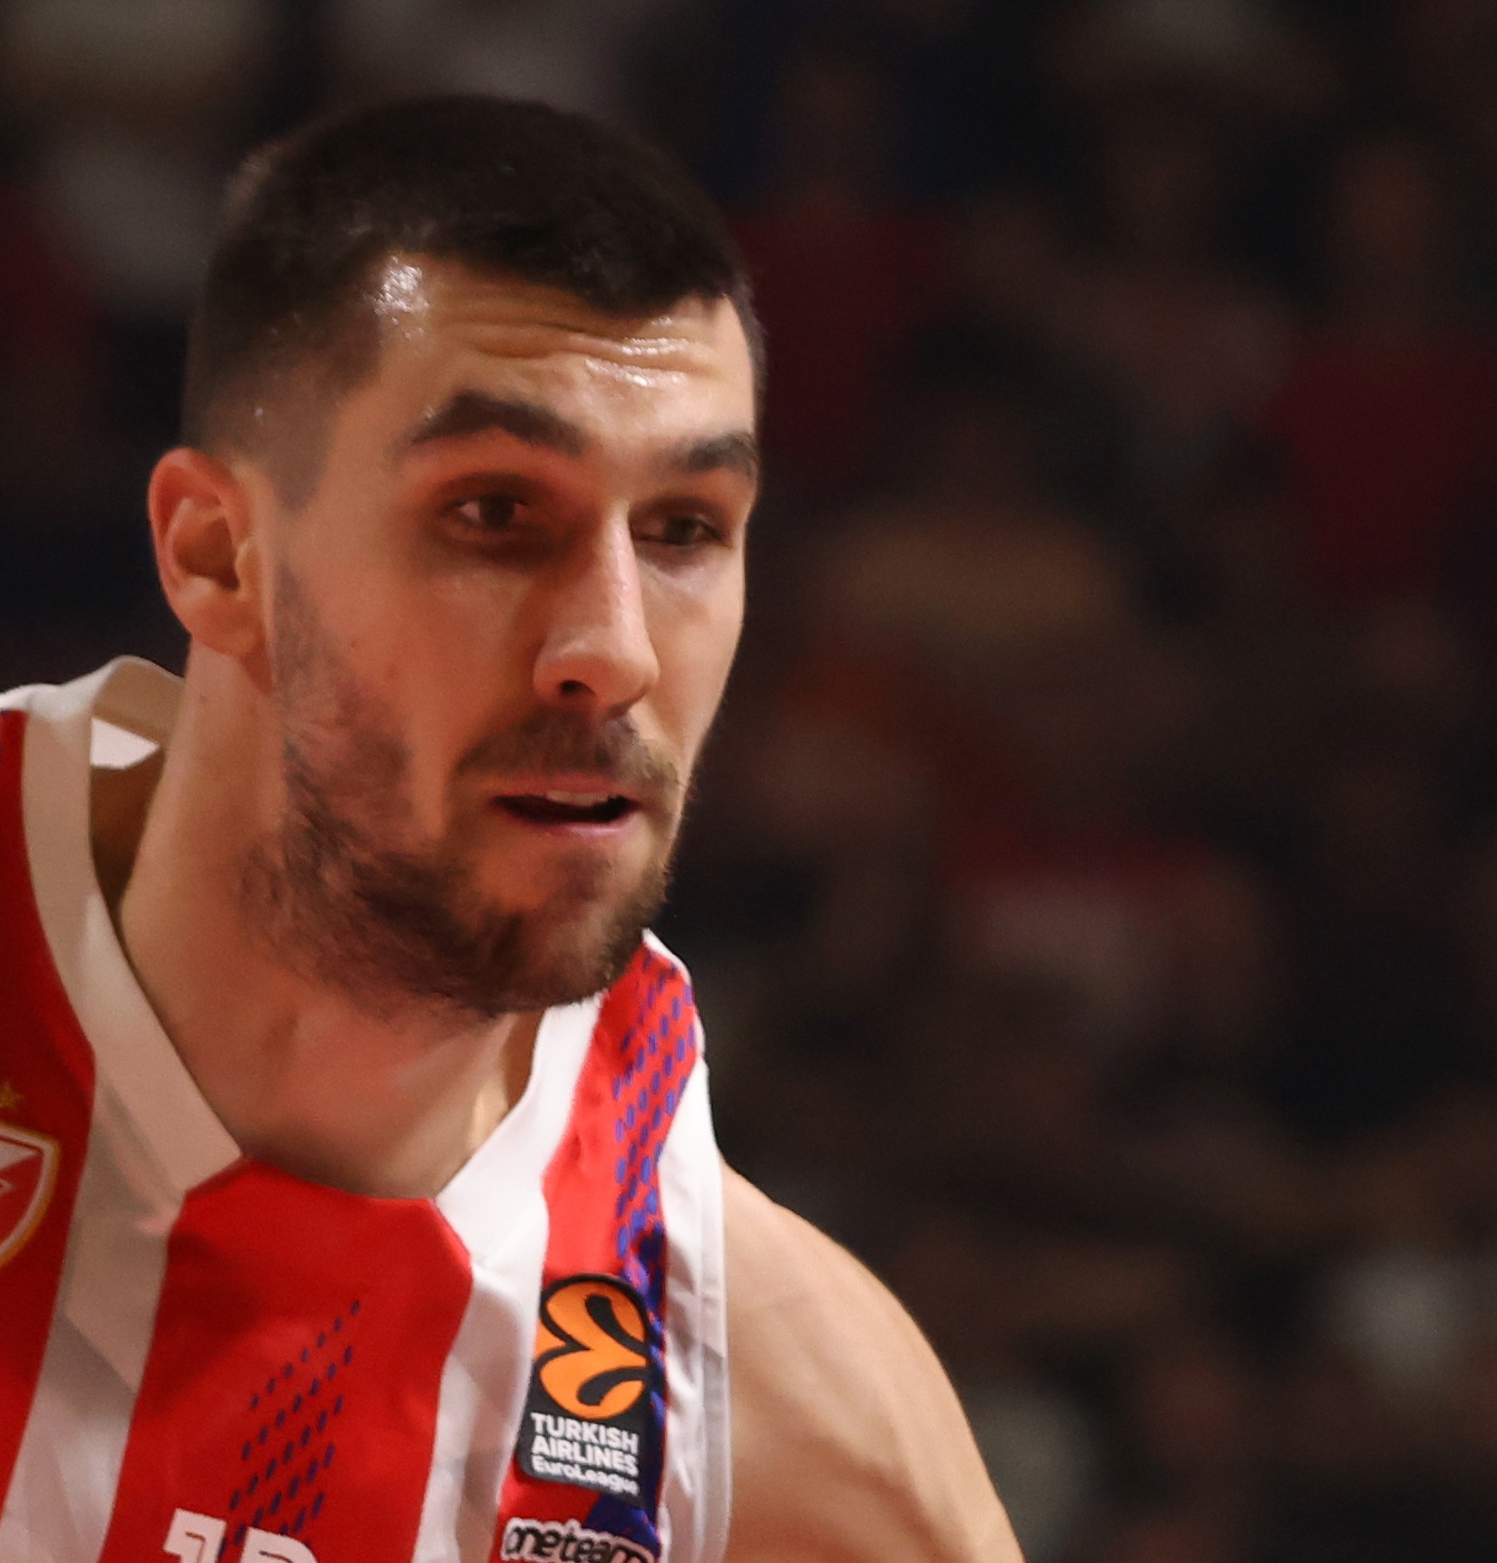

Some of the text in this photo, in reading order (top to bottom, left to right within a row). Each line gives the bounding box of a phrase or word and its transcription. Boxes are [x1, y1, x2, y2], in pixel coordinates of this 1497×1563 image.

[530, 1412, 639, 1455] TURKISH
[531, 1436, 639, 1478] AIRLINES
[531, 1455, 640, 1497] EuroLeague
